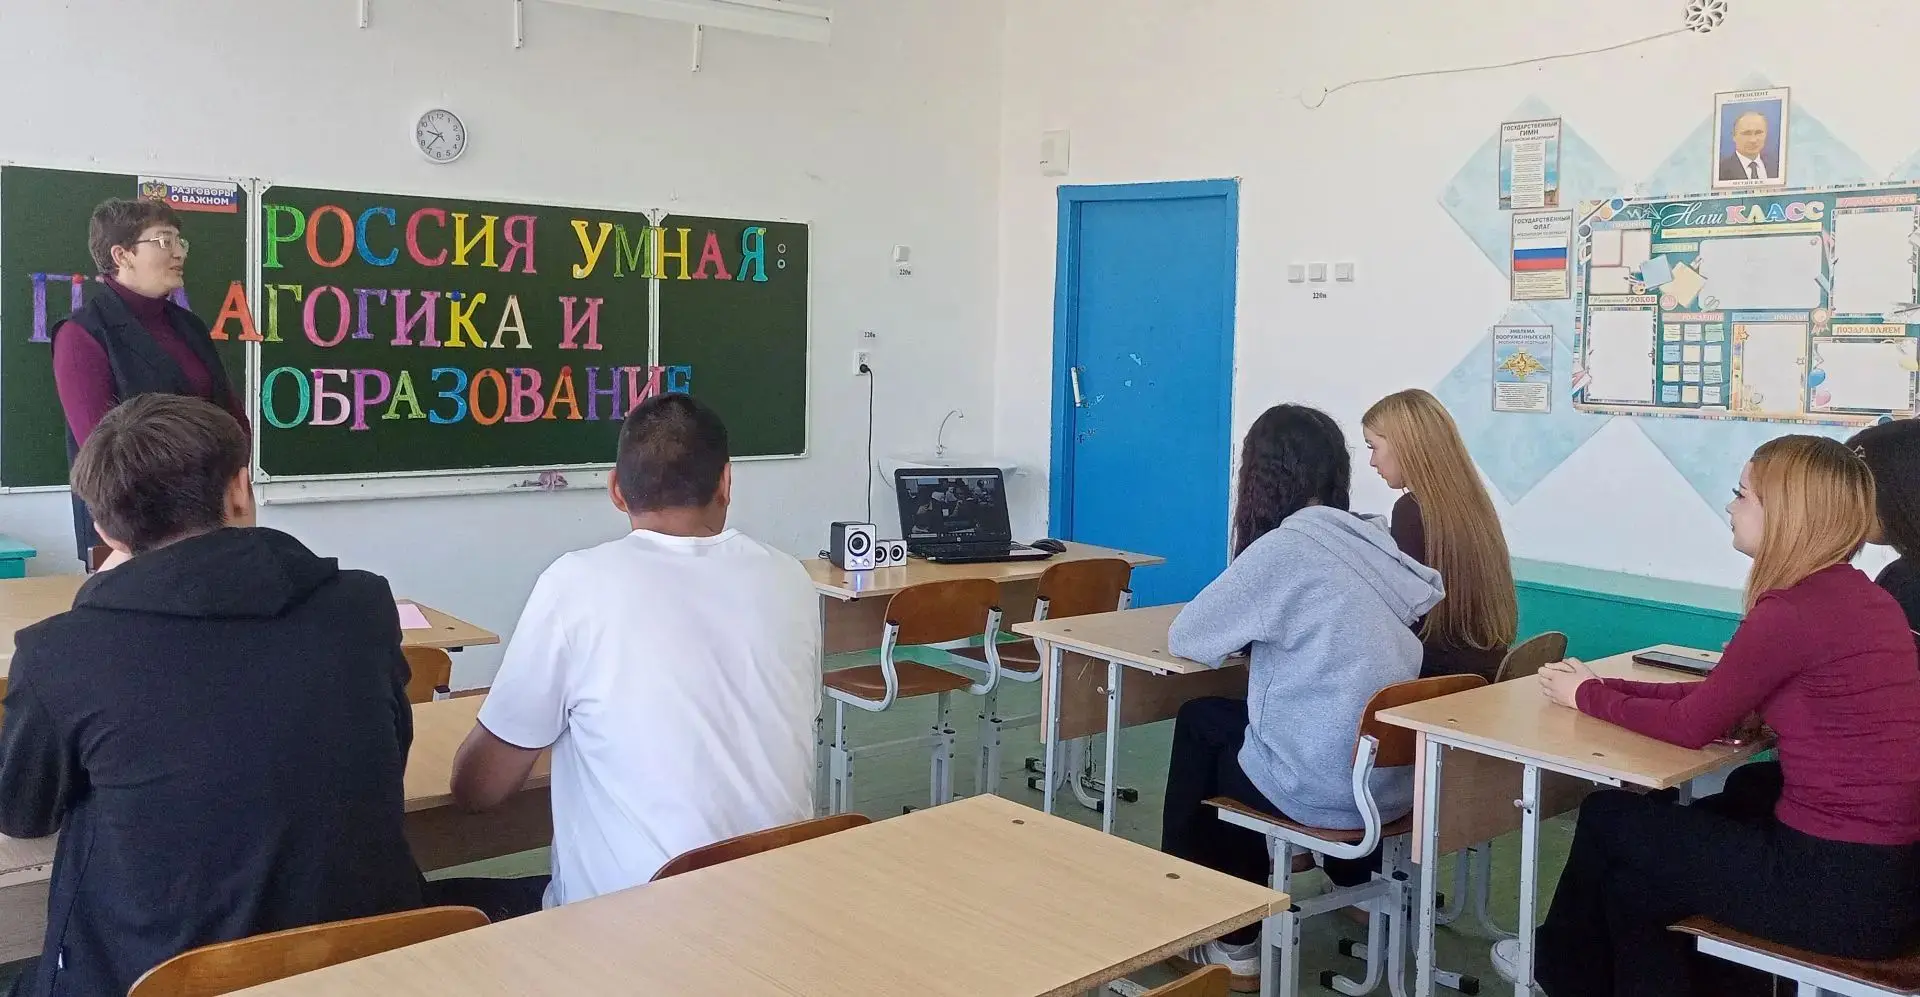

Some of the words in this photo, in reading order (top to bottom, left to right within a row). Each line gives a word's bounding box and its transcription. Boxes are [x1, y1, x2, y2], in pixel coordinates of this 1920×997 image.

[1503, 121, 1558, 131] ГОСУДАРСТВЕННЫЙ
[171, 186, 234, 198] РАЗГОВОРЫ
[171, 194, 180, 202] О
[181, 195, 229, 205] ВАЖНОМ
[1659, 202, 1724, 225] Наш
[1725, 201, 1825, 224] КЛАСС
[262, 203, 538, 275] РОССИЯ
[28, 272, 533, 349] ПАГОГИКА
[558, 295, 604, 351] И
[1836, 324, 1901, 334] ПОЗДРАВЛЯЕМ
